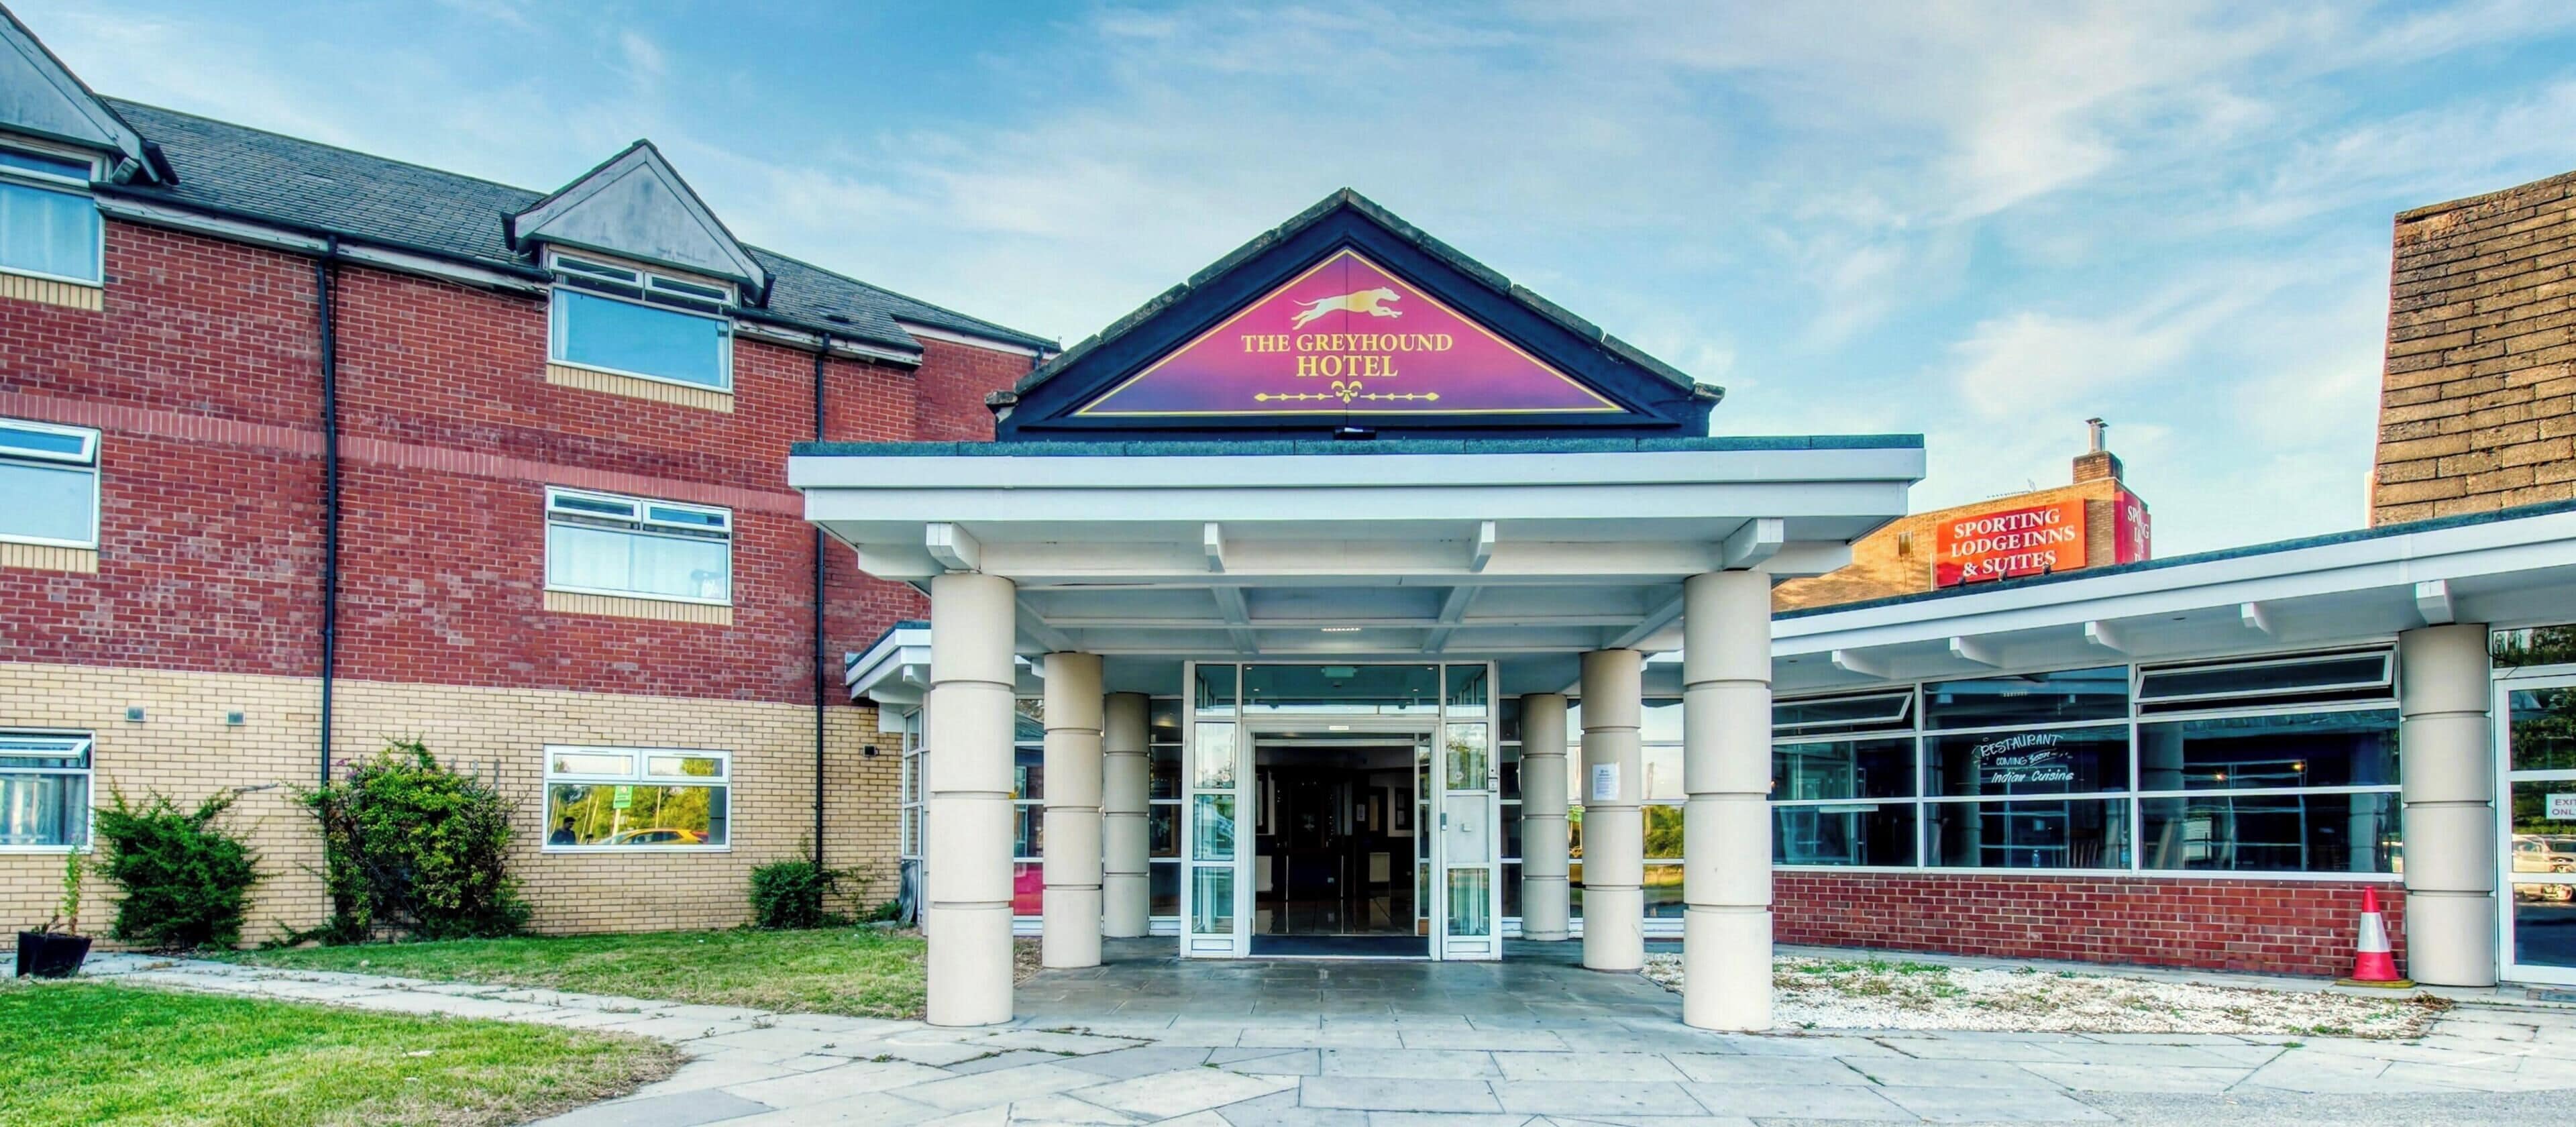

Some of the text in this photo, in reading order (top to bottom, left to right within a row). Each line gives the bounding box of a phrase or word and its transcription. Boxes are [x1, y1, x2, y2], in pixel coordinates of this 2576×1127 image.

[1241, 333, 1454, 353] THE GREYHOUND
[1295, 354, 1399, 376] HOTEL
[1953, 508, 2061, 539] SPORTING
[1951, 524, 2076, 558] LODGE INNS
[1962, 549, 2057, 578] & SUITES
[1980, 734, 2063, 757] RESTAURANT
[1996, 756, 2028, 766] COMING
[1990, 768, 2075, 784] Indian Cuisine
